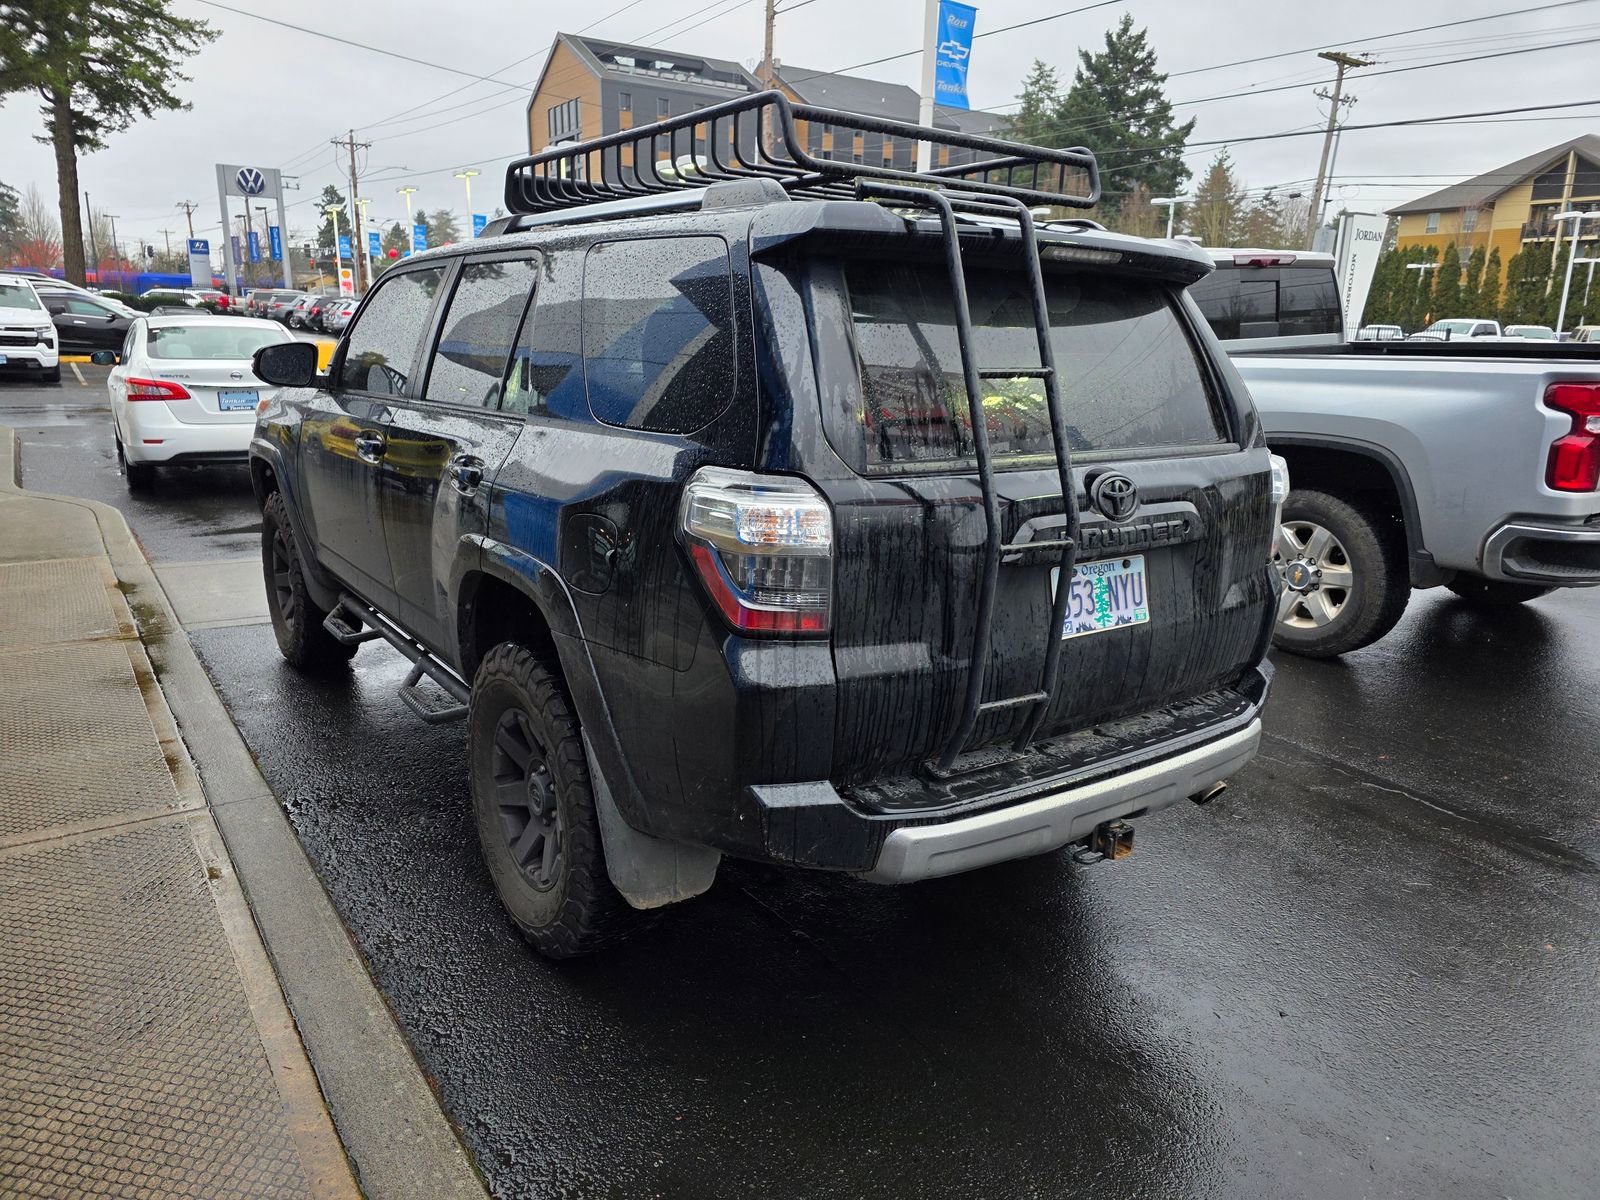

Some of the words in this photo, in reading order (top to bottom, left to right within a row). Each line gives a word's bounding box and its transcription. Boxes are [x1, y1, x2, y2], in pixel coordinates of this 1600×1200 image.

[947, 15, 968, 28] Ron
[1355, 228, 1383, 241] JORDAN
[1081, 562, 1115, 577] Oregon
[1107, 572, 1143, 612] NYU
